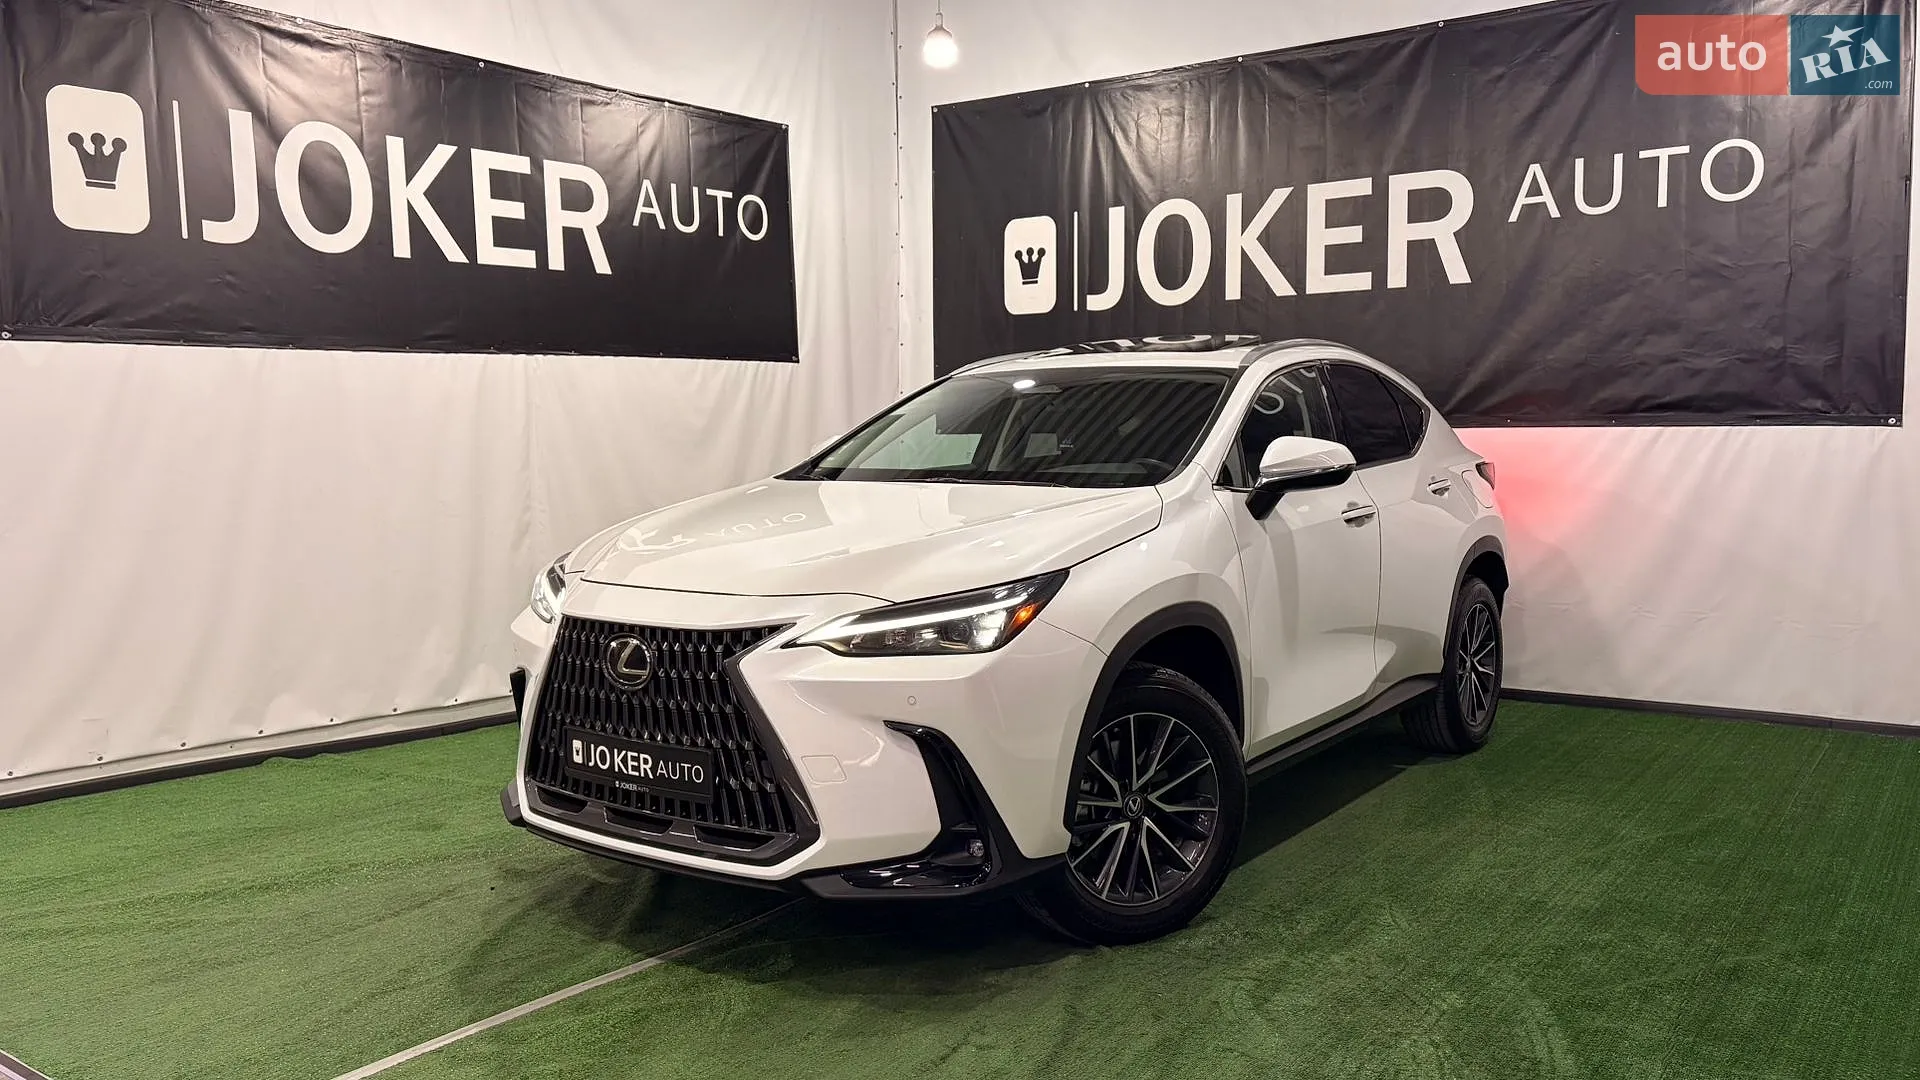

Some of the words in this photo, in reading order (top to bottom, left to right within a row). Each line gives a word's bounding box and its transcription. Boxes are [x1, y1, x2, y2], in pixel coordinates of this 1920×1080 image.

[202, 108, 612, 275] JOKER
[633, 178, 768, 241] AUTO
[1087, 170, 1474, 311] JOKER
[1508, 138, 1765, 223] AUTO
[588, 744, 654, 779] JOKER
[656, 760, 704, 783] AUTO
[620, 782, 638, 791] JOKER
